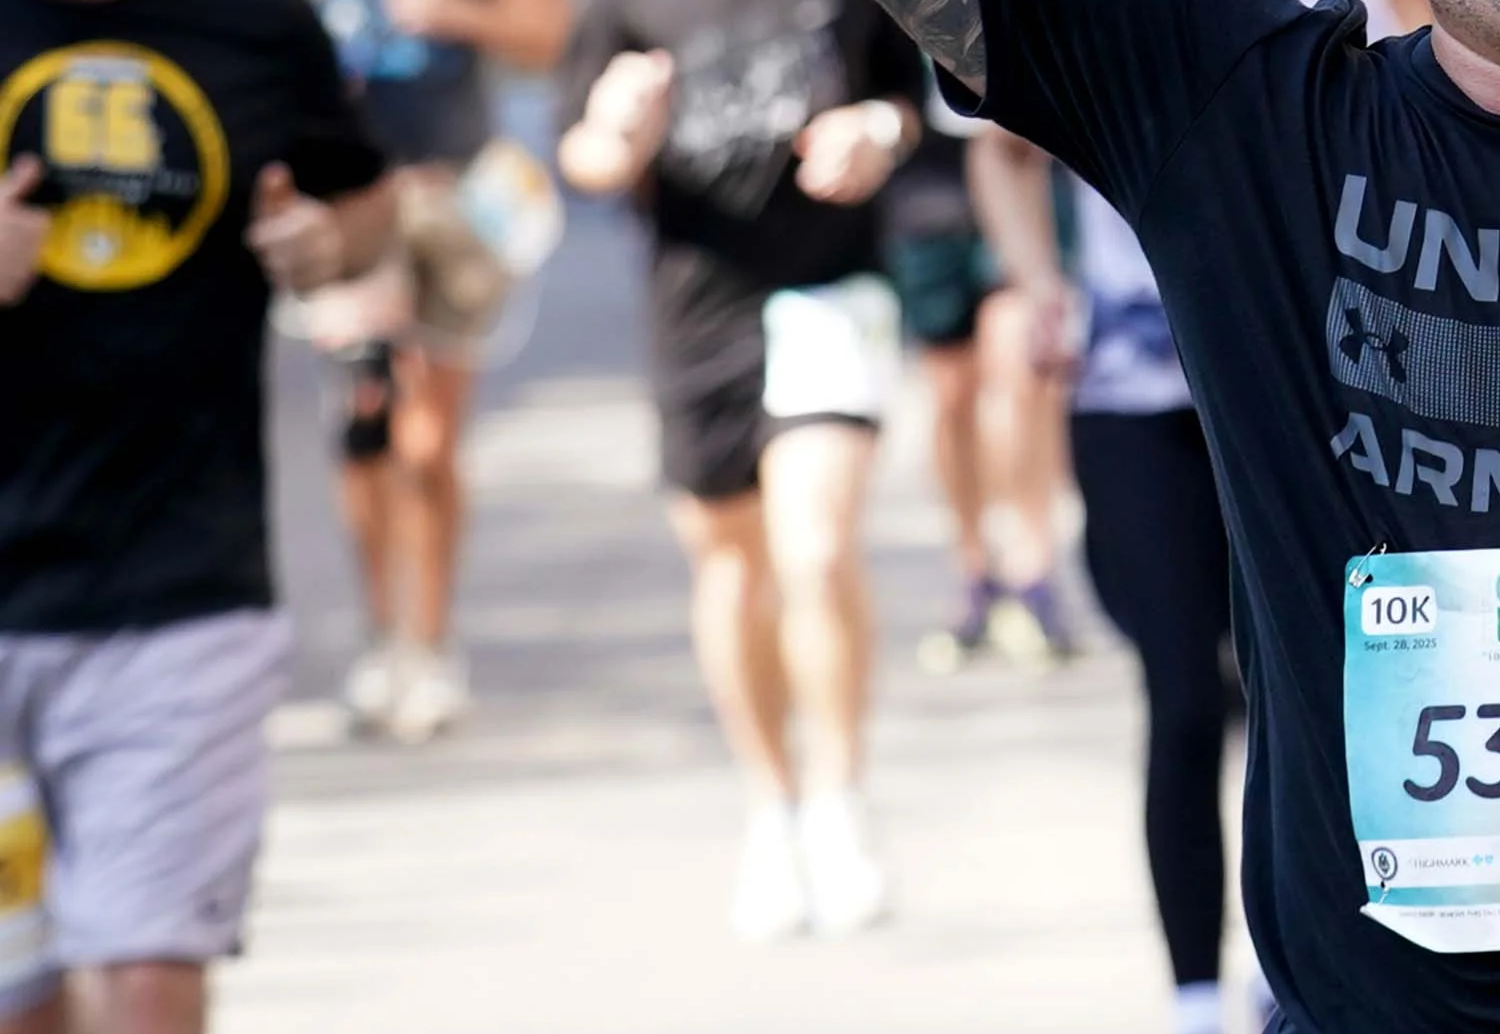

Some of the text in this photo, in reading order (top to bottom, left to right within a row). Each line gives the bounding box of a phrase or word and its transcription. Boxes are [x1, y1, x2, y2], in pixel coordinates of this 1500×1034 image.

[1371, 595, 1430, 625] 10K
[1363, 637, 1438, 653] Sept. 28, 2025
